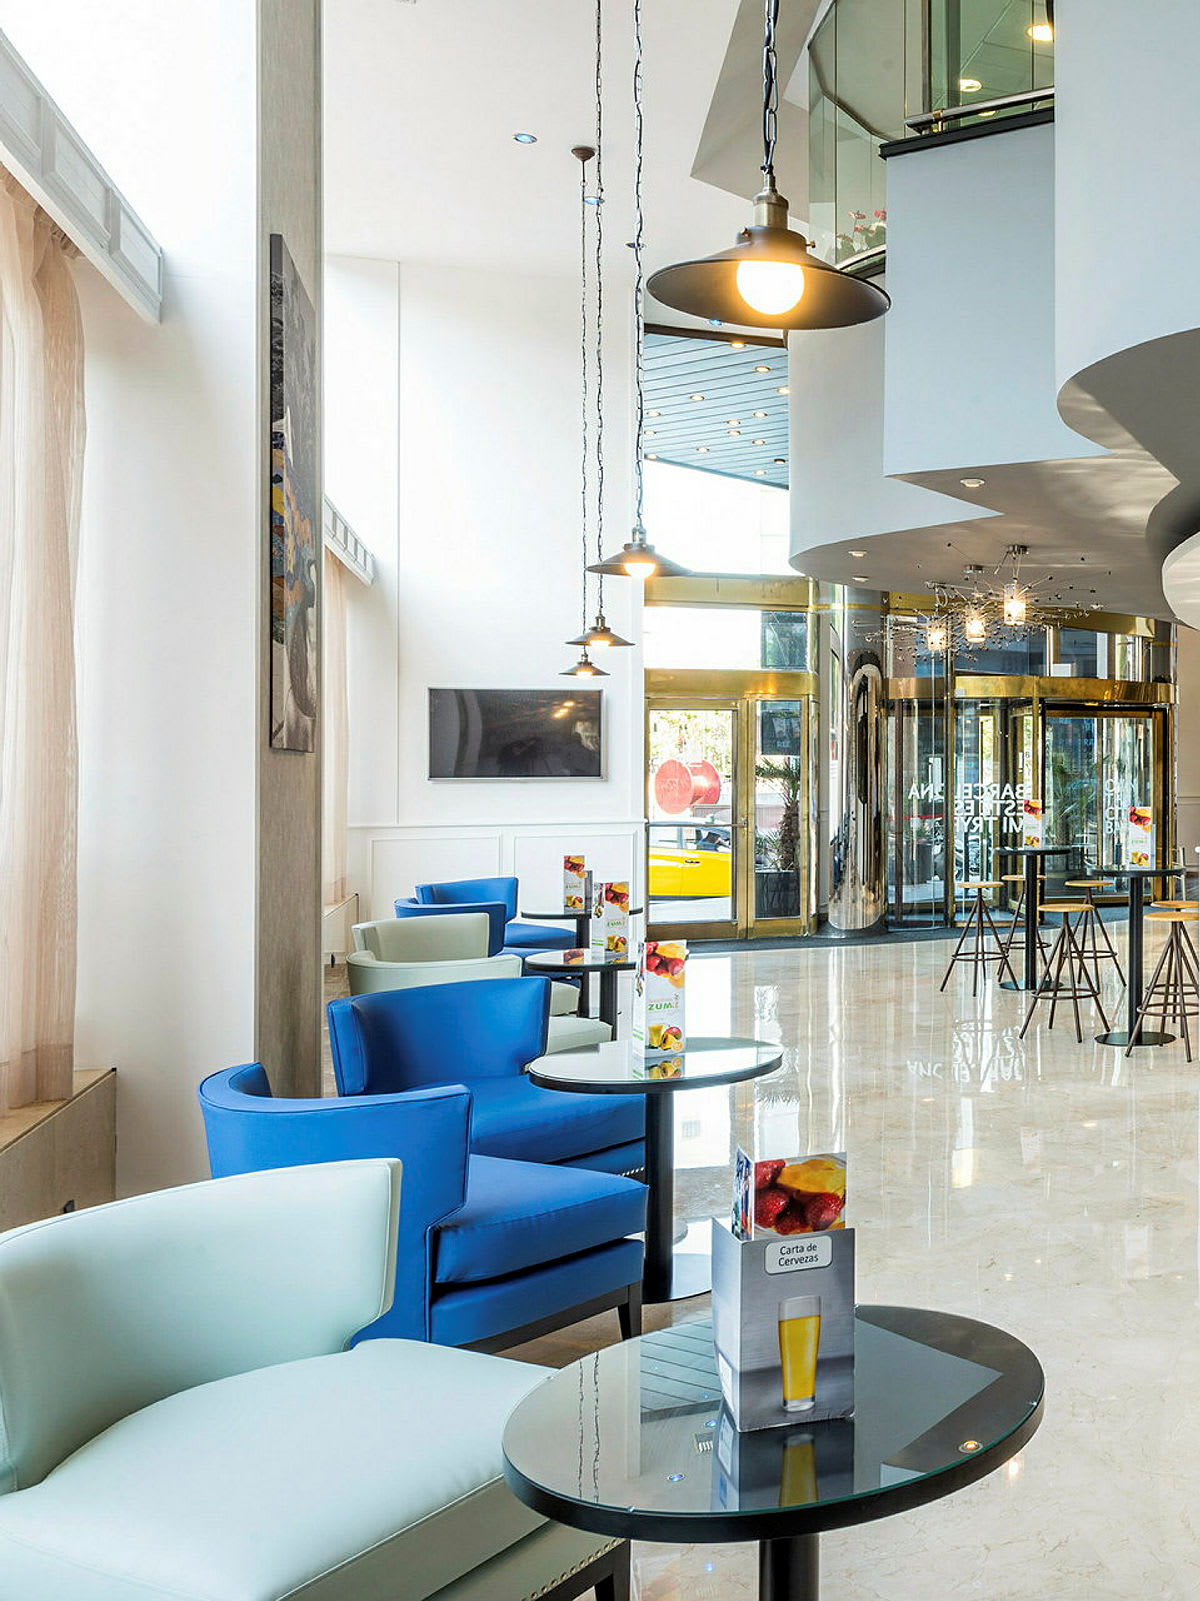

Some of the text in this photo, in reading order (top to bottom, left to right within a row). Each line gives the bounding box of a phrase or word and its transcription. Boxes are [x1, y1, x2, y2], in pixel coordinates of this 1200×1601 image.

[779, 1242, 818, 1255] Carta de
[778, 1254, 819, 1267] Cervezas
